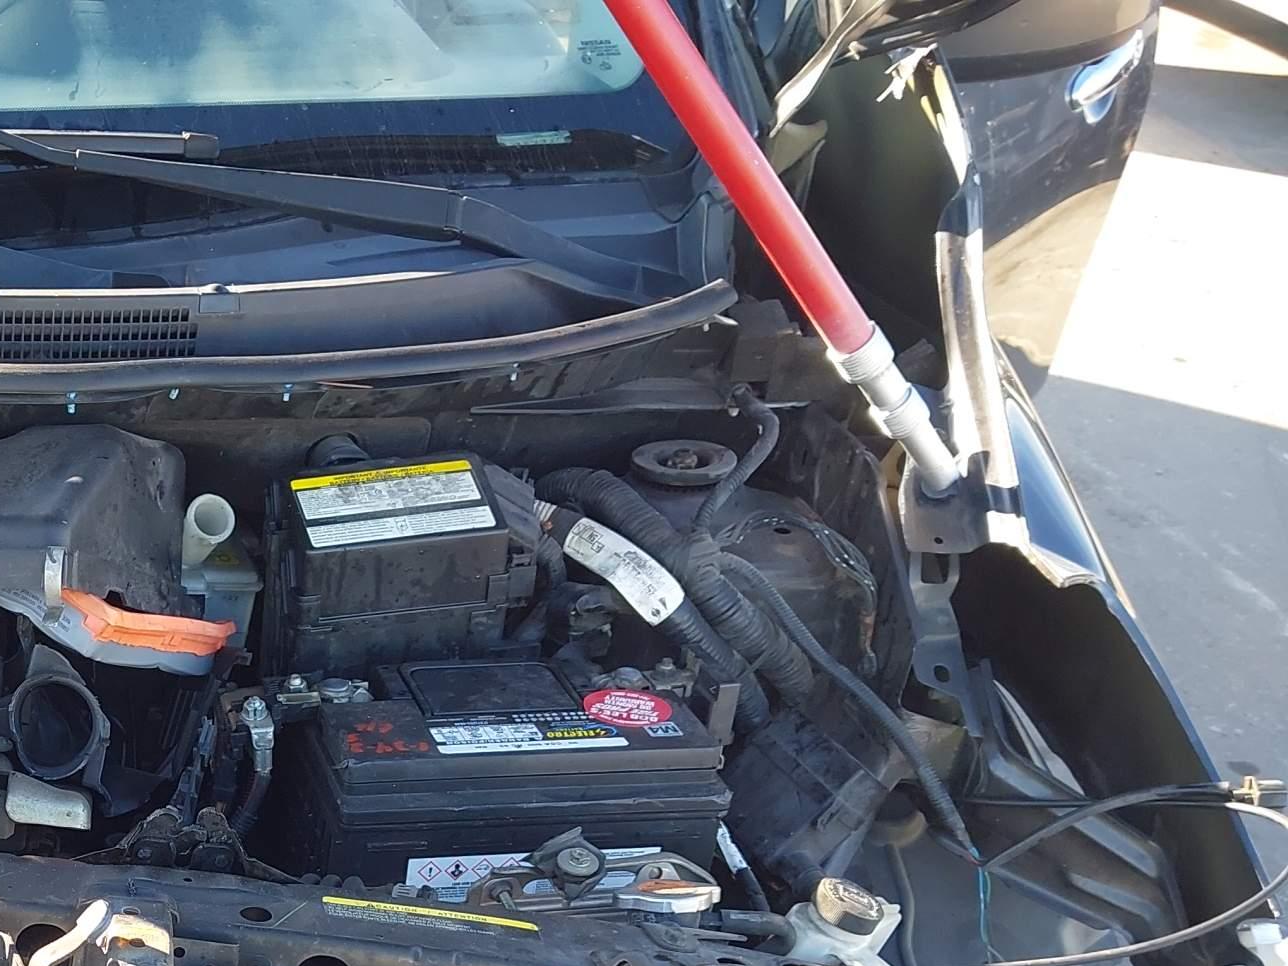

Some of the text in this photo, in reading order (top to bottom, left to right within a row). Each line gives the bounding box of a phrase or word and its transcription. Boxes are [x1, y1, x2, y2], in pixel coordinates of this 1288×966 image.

[546, 729, 595, 738] ELECTRO
[375, 903, 488, 922] CAUTION ATTENTION
